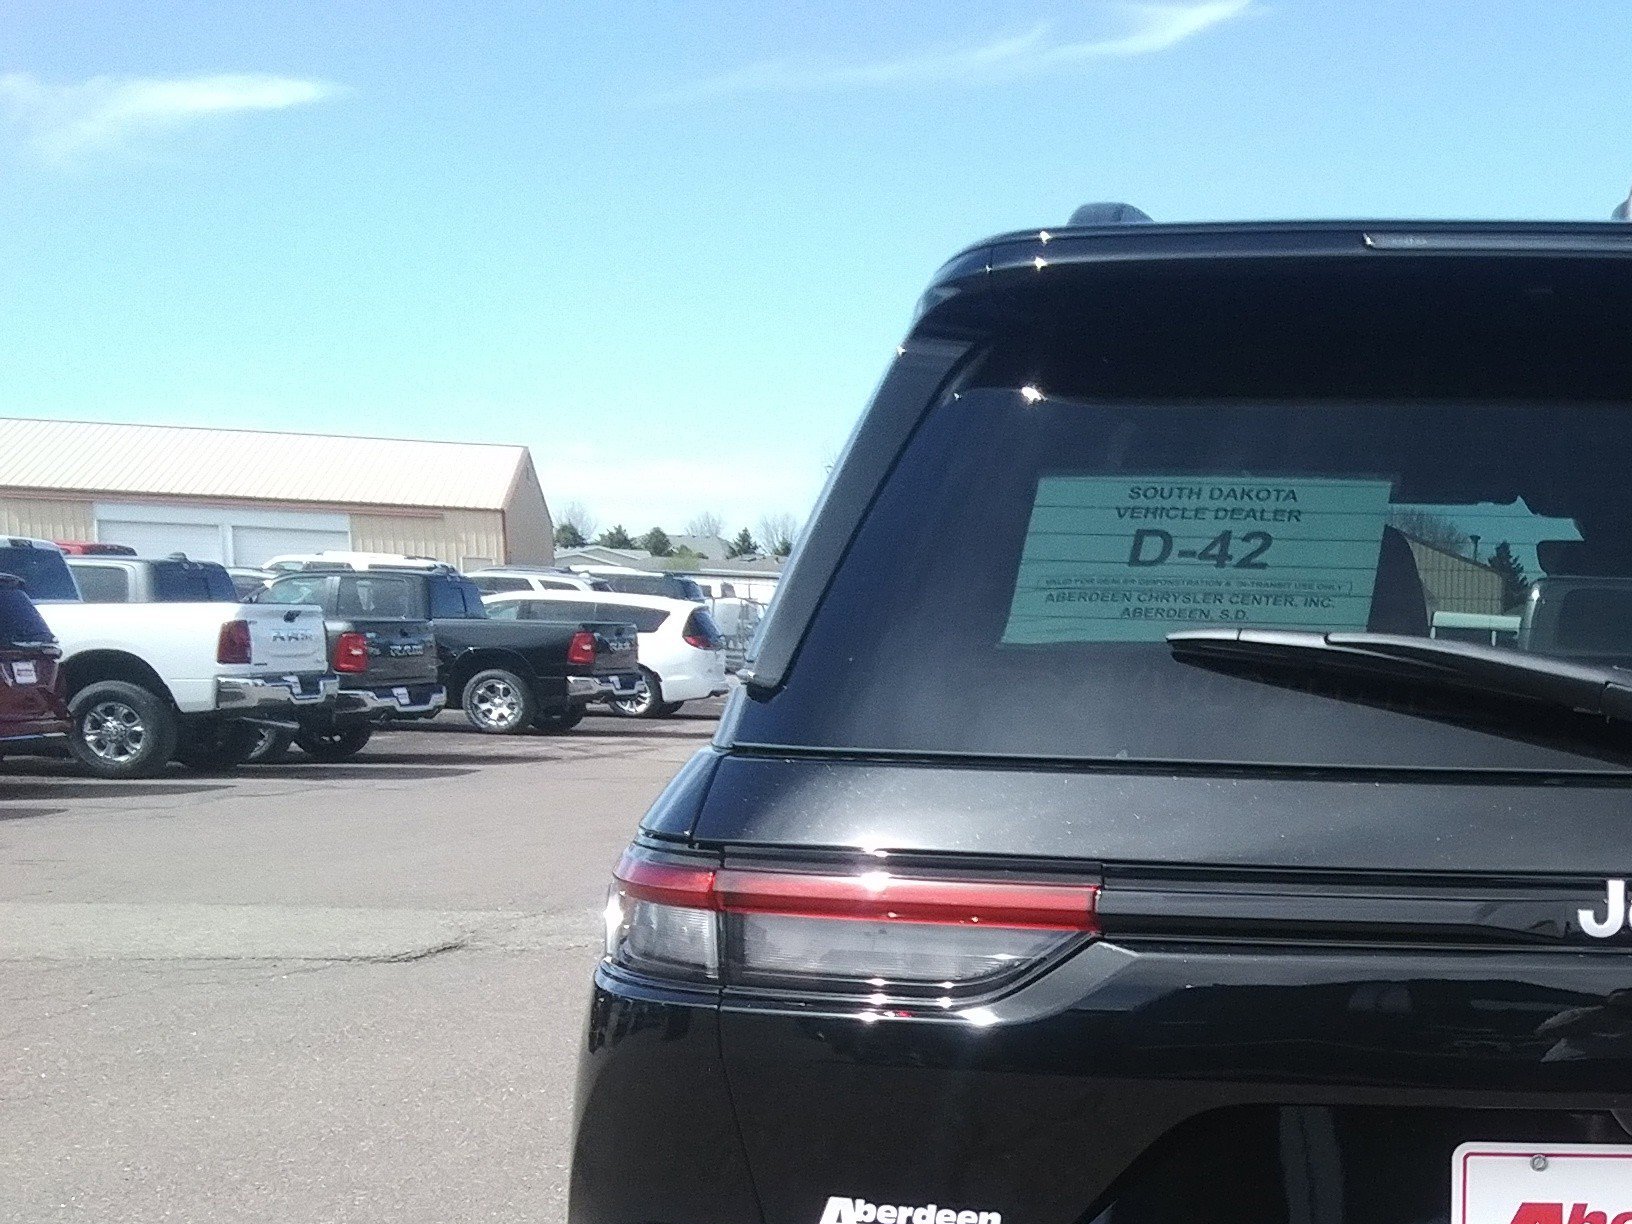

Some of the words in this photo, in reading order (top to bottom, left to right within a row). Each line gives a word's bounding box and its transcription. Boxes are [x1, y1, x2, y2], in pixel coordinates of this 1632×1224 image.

[1128, 486, 1203, 501] SOUTH
[1208, 487, 1298, 503] DAKOTA
[1115, 506, 1207, 521] VEHICLE
[1213, 507, 1302, 523] DEALER
[1128, 528, 1274, 570] D-42
[1045, 591, 1132, 603] ABERDEEN
[1136, 592, 1224, 605] CHRYSLER
[1303, 596, 1336, 609] INC.
[1219, 608, 1249, 621] S.D.
